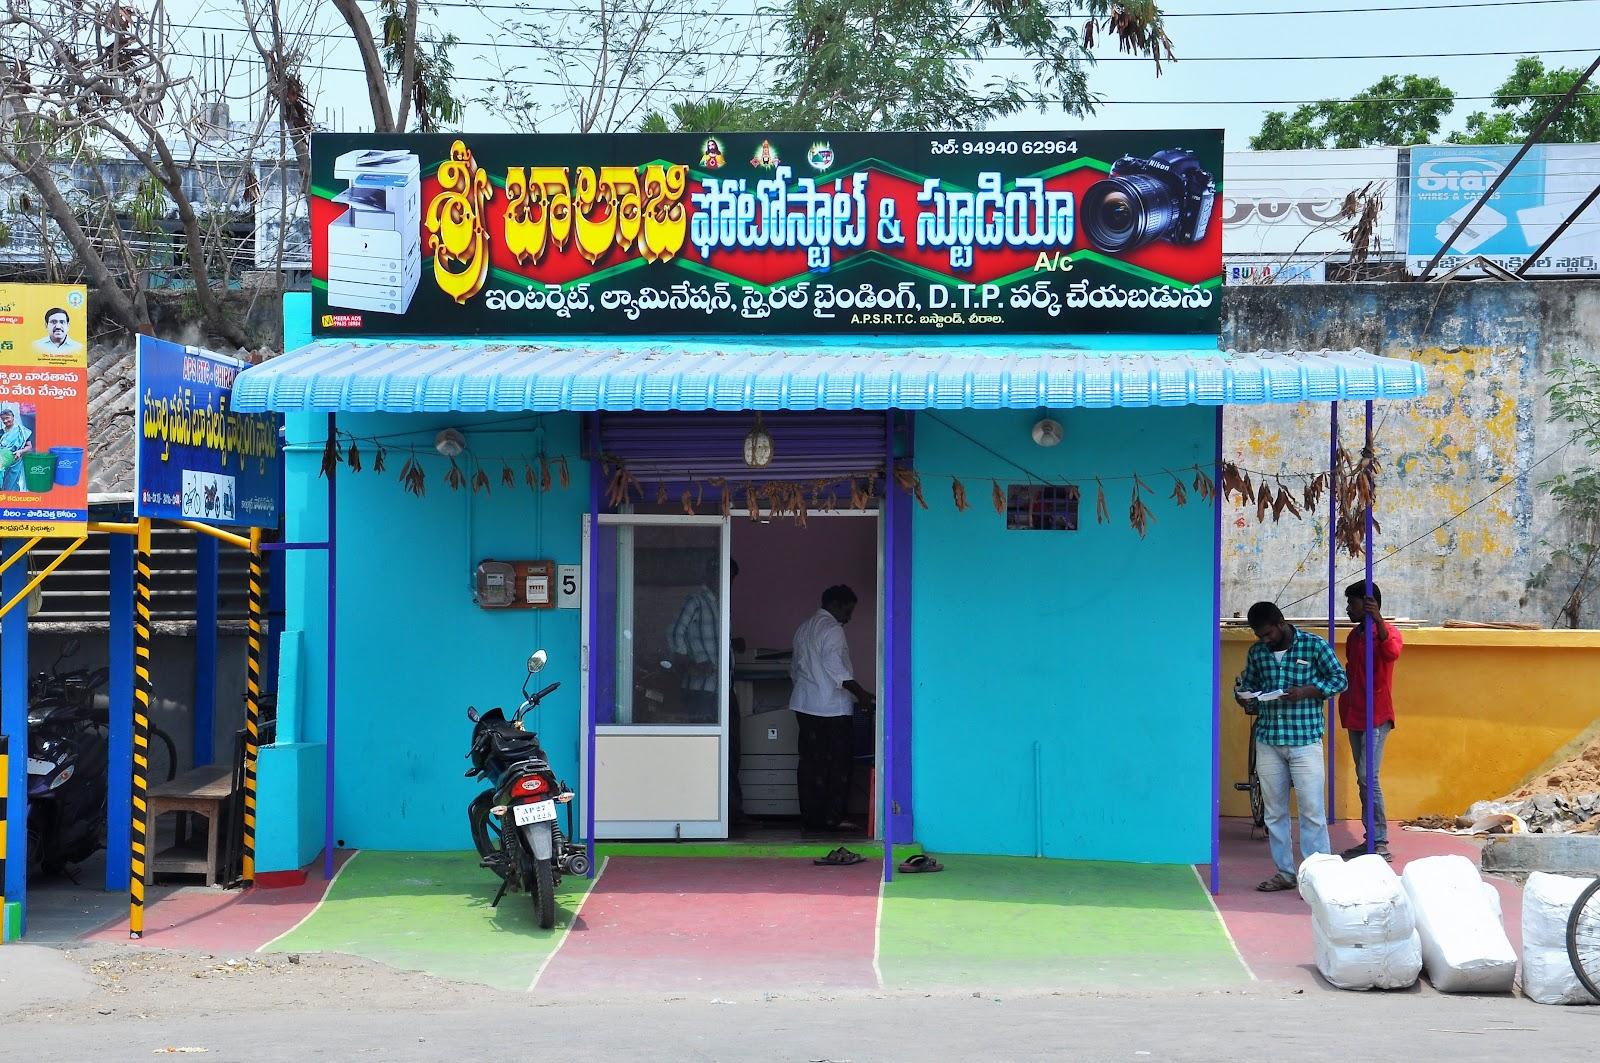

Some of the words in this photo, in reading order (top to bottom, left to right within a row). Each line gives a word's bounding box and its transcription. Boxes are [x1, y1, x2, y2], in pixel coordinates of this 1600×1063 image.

[962, 141, 1018, 155] 94940
[1022, 141, 1078, 155] 62964
[1148, 159, 1170, 171] Nikon
[1418, 192, 1450, 201] WIRES
[1452, 192, 1460, 200] &
[425, 139, 493, 305] శ్రీ
[877, 197, 905, 244] &
[916, 172, 1074, 268] స్టూడియో
[1034, 252, 1074, 272] A/c
[929, 284, 1003, 309] D.T.P.
[1010, 281, 1062, 317] వర్క్
[1066, 279, 1213, 309] చేయబడును
[850, 313, 917, 324] A.P.S.R.T.C.
[563, 575, 577, 595] 5
